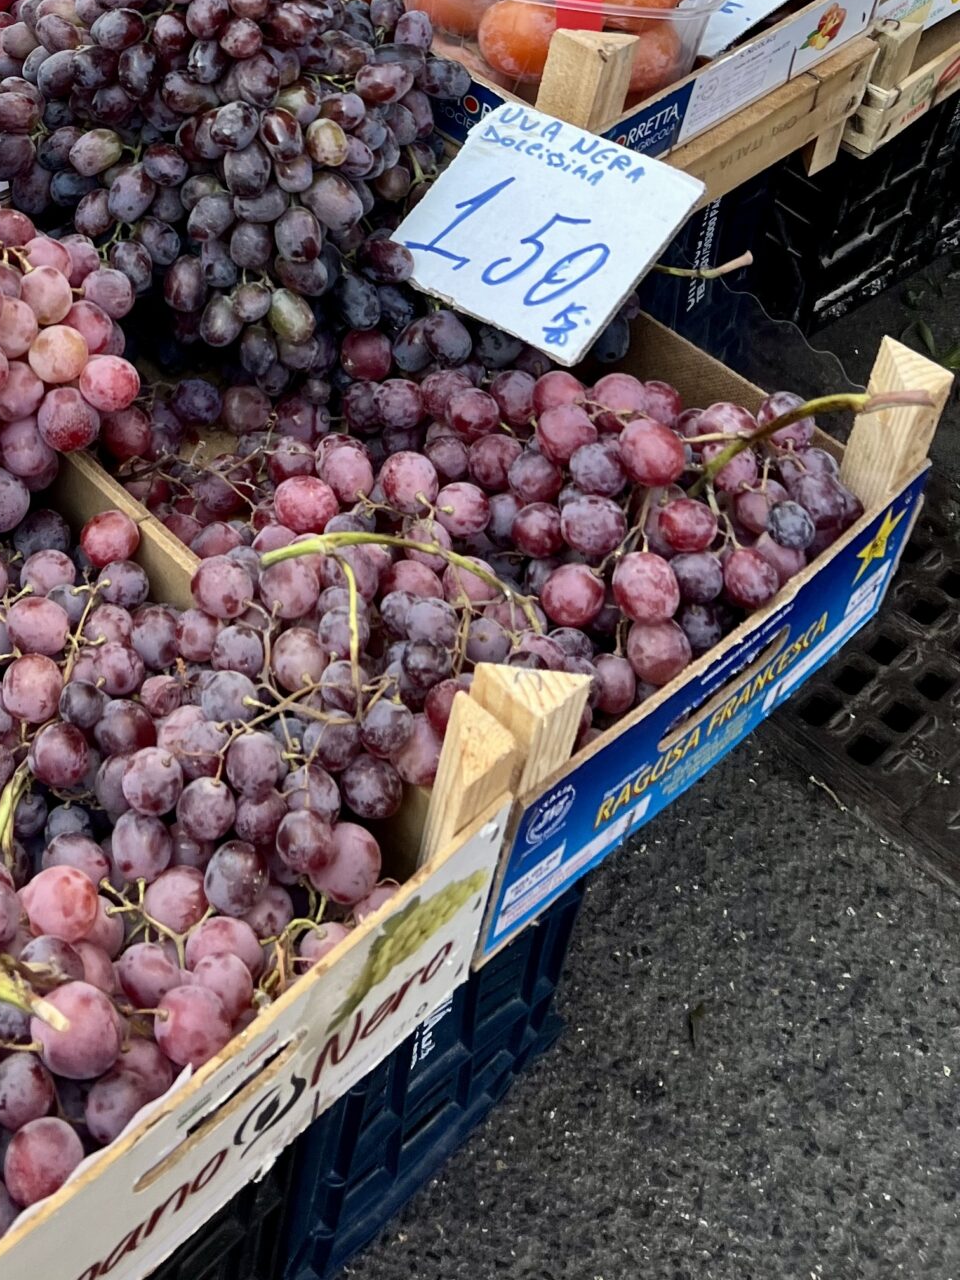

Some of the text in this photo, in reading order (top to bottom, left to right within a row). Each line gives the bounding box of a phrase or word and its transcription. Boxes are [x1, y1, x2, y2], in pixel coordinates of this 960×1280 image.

[498, 106, 647, 184] UVA NERA
[593, 726, 701, 830] RAGUSA
[706, 610, 829, 737] FRANCESCA
